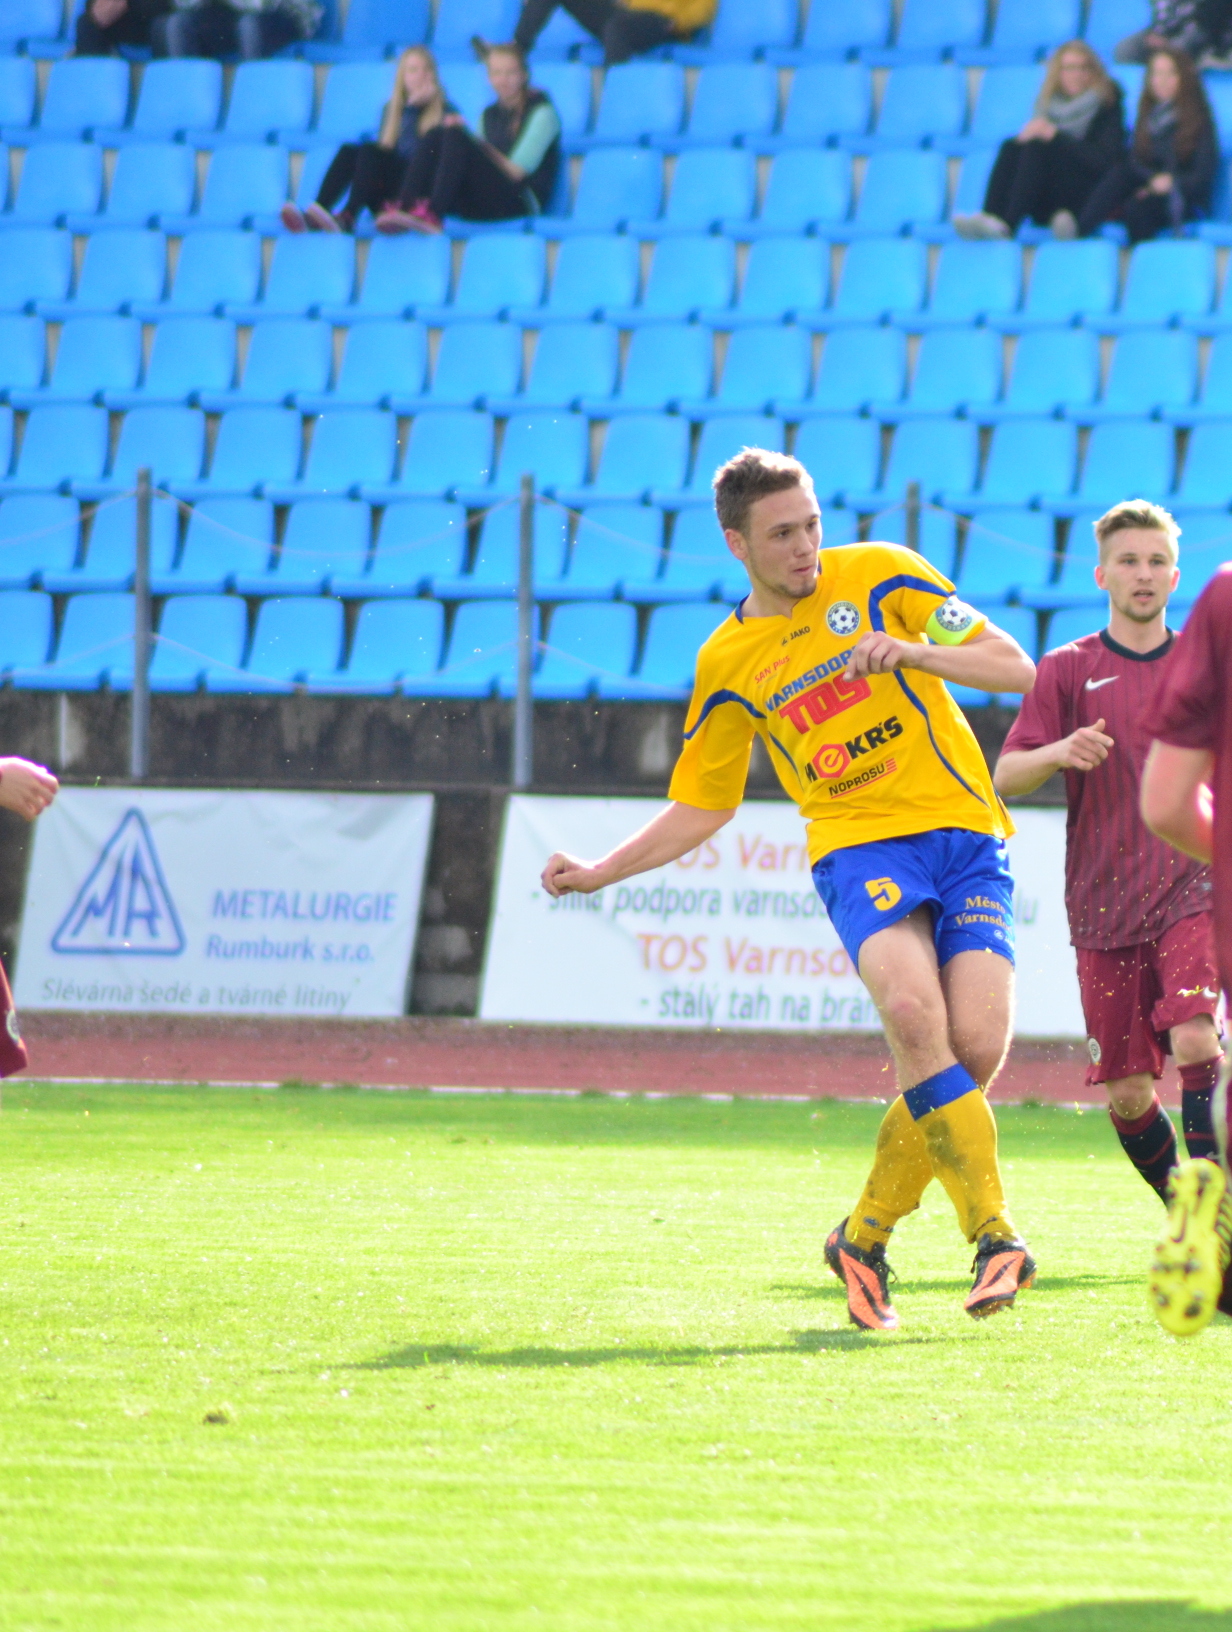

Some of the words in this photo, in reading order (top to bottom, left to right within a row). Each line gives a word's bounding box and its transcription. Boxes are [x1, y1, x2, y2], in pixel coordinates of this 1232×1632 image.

[789, 625, 810, 641] JAKO
[754, 666, 772, 684] SAN
[779, 672, 872, 735] TOS
[211, 888, 399, 923] METALURGIE
[612, 877, 721, 924] podpora
[865, 876, 902, 911] 5
[965, 895, 1005, 914] Město
[206, 933, 315, 962] Rumburk
[322, 939, 375, 963] s.r.o.
[636, 933, 708, 973] TOS
[41, 977, 134, 1003] Slévárna
[138, 979, 193, 1005] šedé
[200, 986, 210, 1006] a
[219, 980, 288, 1008] tvárné
[297, 982, 352, 1012] litiny
[658, 980, 721, 1023] stálý
[728, 984, 771, 1021] tah
[780, 991, 811, 1022] na
